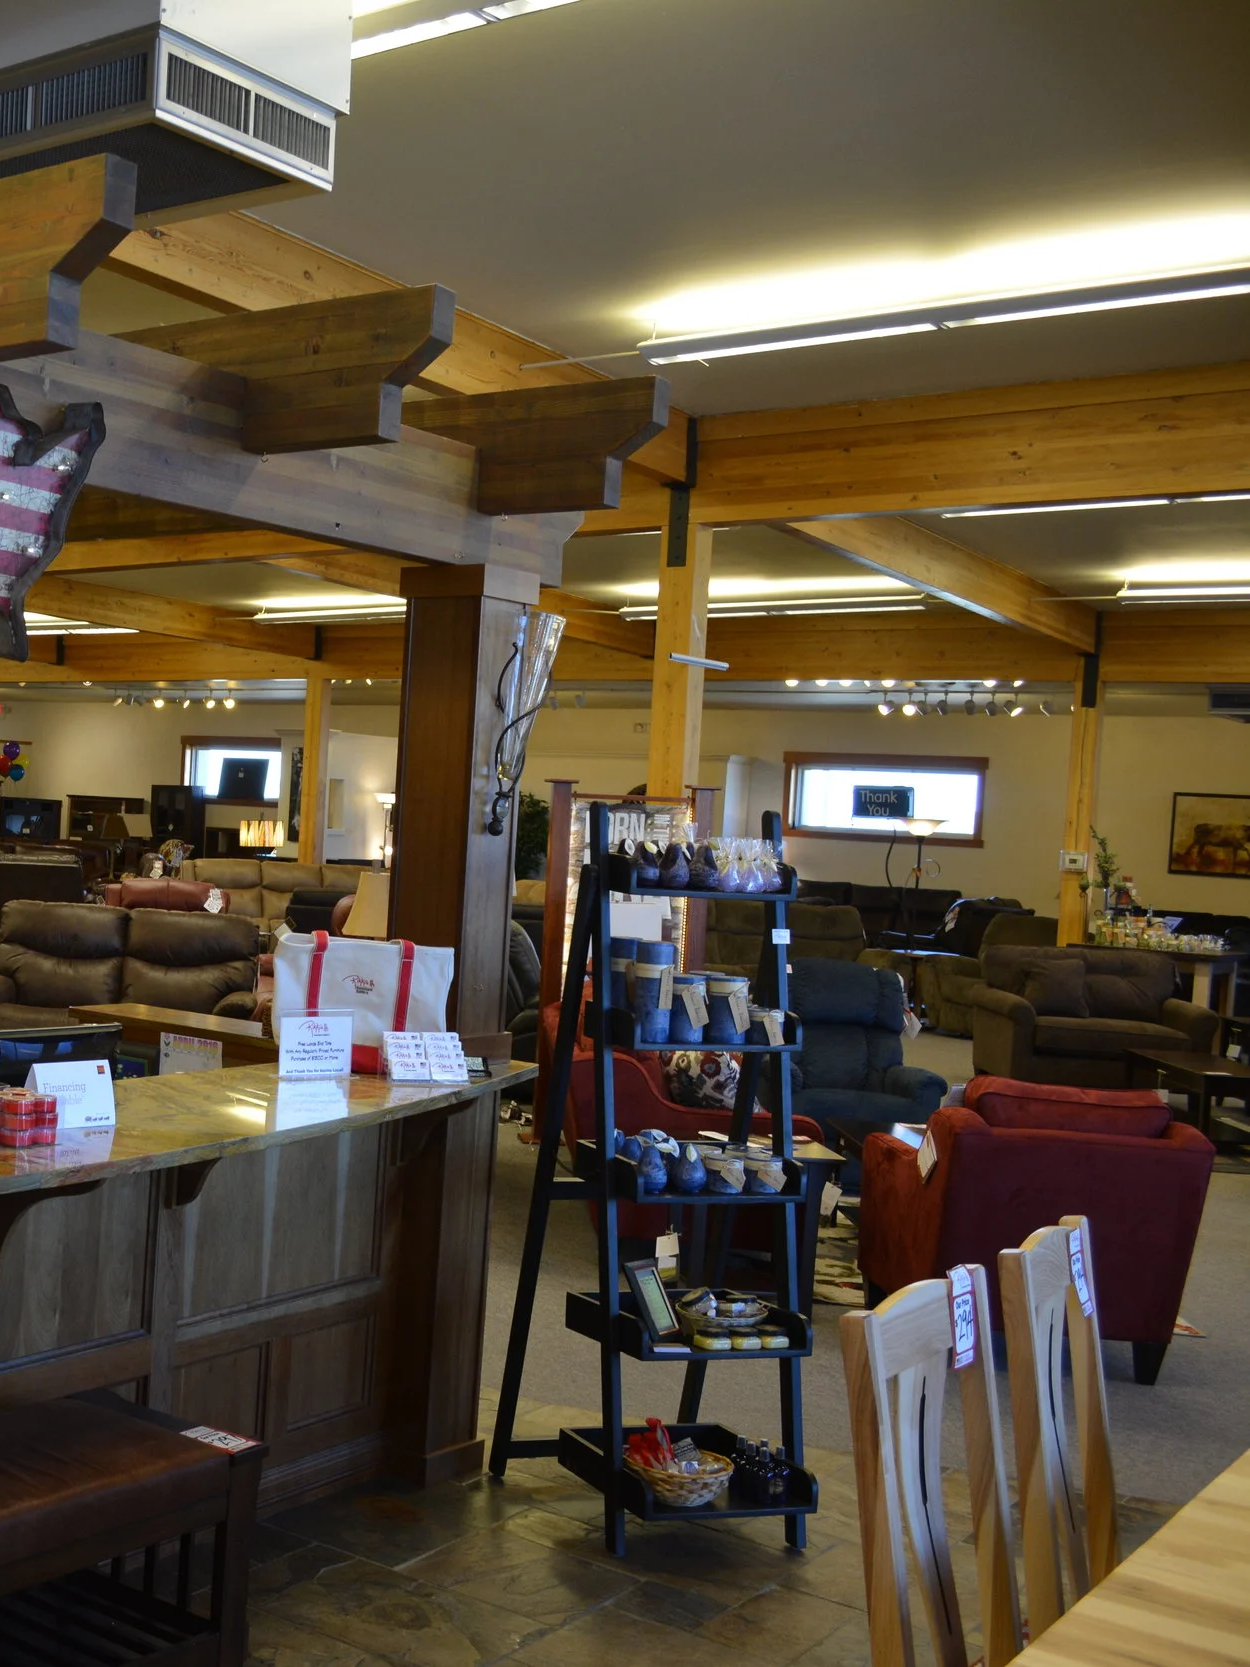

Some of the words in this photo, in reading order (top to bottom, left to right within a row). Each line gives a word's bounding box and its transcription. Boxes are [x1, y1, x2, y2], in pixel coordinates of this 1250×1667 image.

[860, 790, 898, 803] Thank
[867, 804, 889, 816] You
[43, 1082, 87, 1094] Financing
